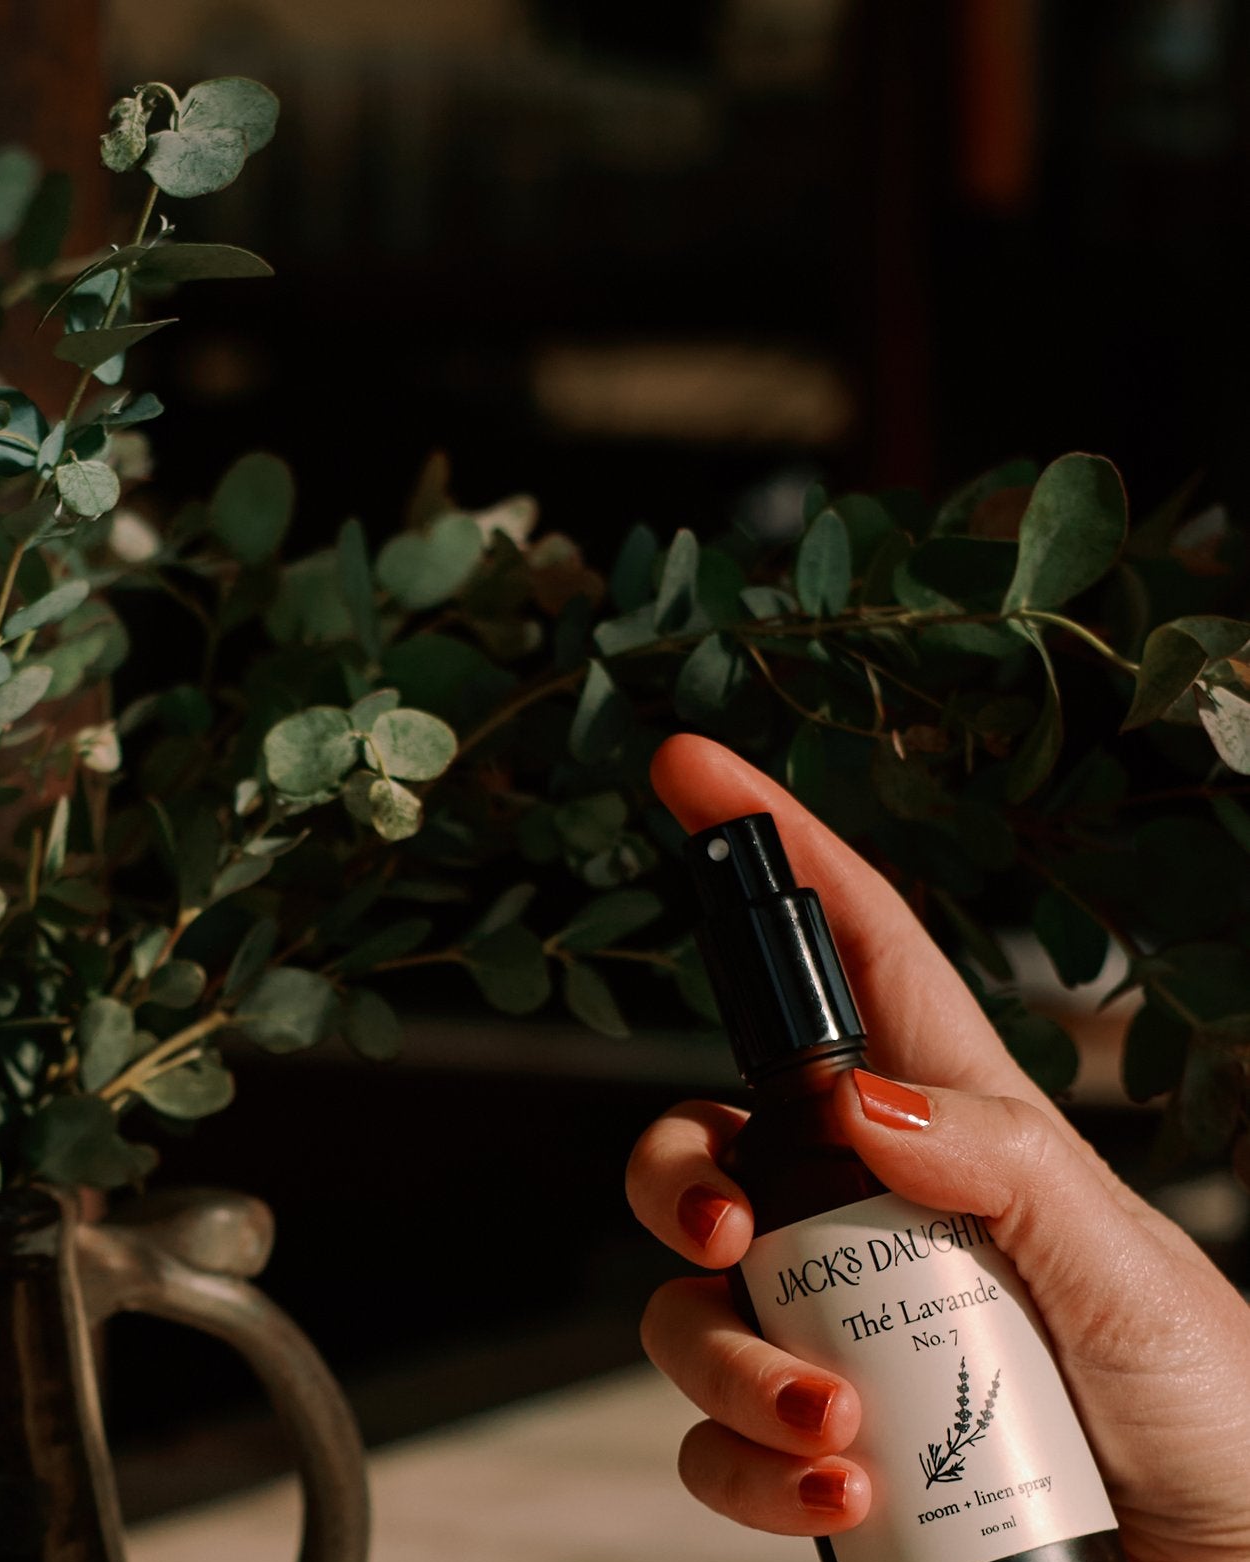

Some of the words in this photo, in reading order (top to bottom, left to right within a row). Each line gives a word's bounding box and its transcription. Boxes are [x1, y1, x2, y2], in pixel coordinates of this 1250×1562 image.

[776, 1246, 863, 1305] JACK'S
[842, 1303, 894, 1342] Thé
[899, 1277, 999, 1326] Lavande
[912, 1332, 946, 1352] No.
[949, 1329, 959, 1346] 7
[918, 1502, 961, 1525] room
[974, 1486, 1014, 1507] linen
[1018, 1474, 1052, 1495] spray
[981, 1523, 1000, 1537] 100
[1002, 1516, 1017, 1532] ml
